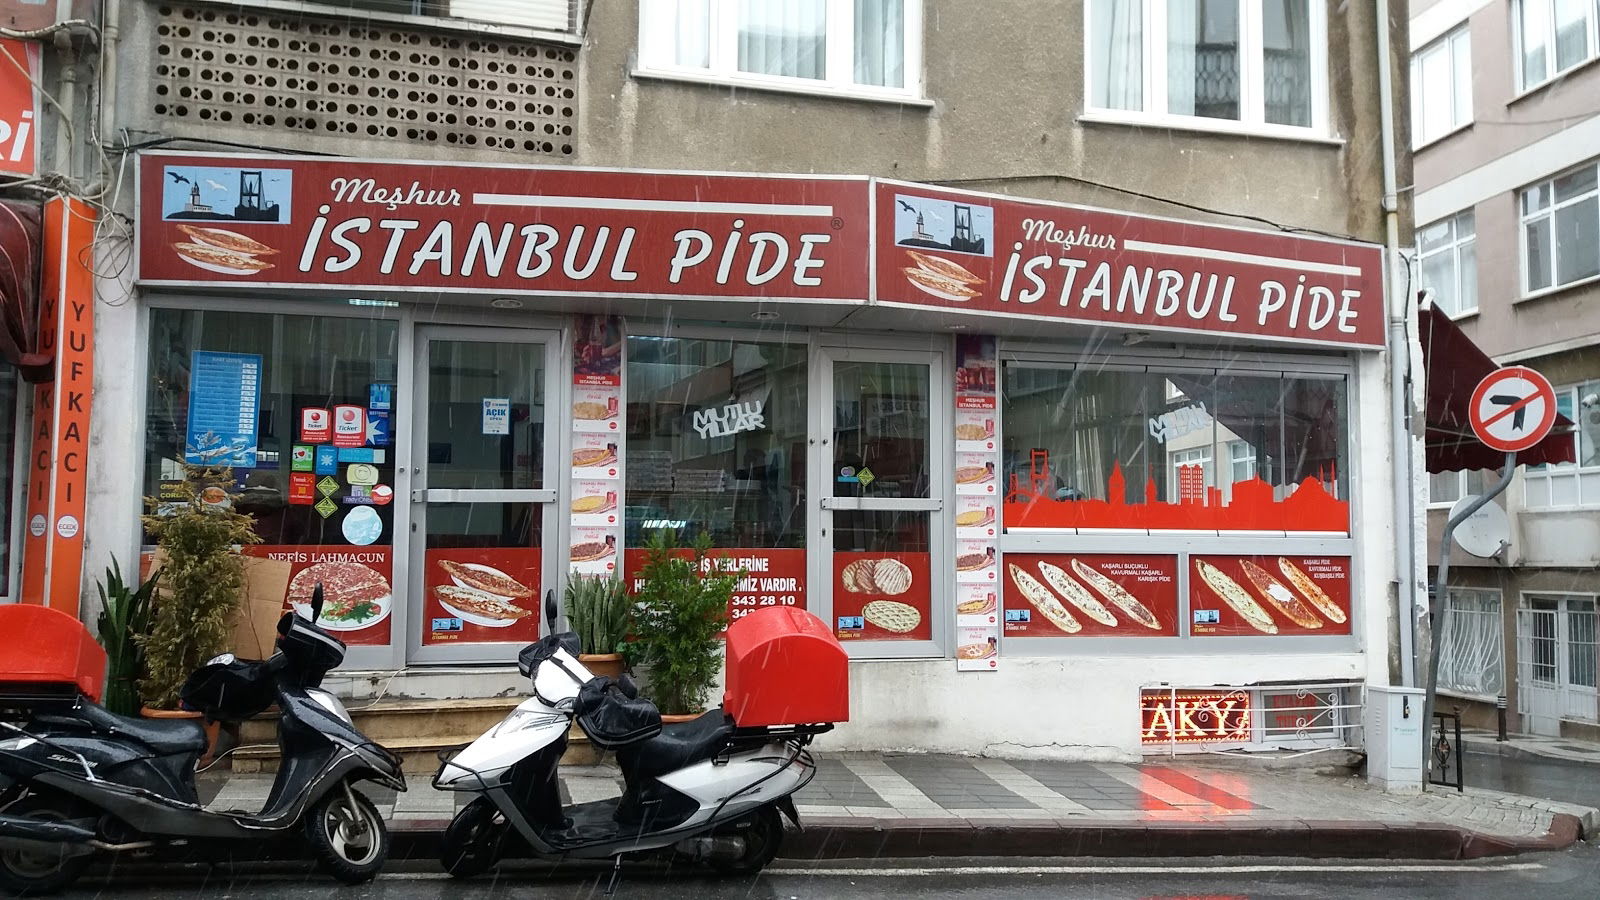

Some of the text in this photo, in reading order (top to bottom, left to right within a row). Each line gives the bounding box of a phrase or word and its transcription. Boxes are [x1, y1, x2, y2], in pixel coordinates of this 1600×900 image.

[330, 177, 461, 211] Meşhur
[298, 204, 831, 287] İSTANBUL PİDE
[1022, 218, 1116, 251] Meşhur
[1000, 241, 1361, 334] İSTANBUL PİDE
[37, 299, 55, 501] YUKACI
[64, 301, 86, 502] YUFKACI
[486, 408, 506, 417] AÇIK
[268, 551, 385, 563] NEFİS LAHMACUN
[700, 555, 711, 574] İŞ
[713, 555, 769, 572] YERLERİNE
[732, 595, 796, 606] 343 28 10
[760, 577, 797, 592] VARDIR
